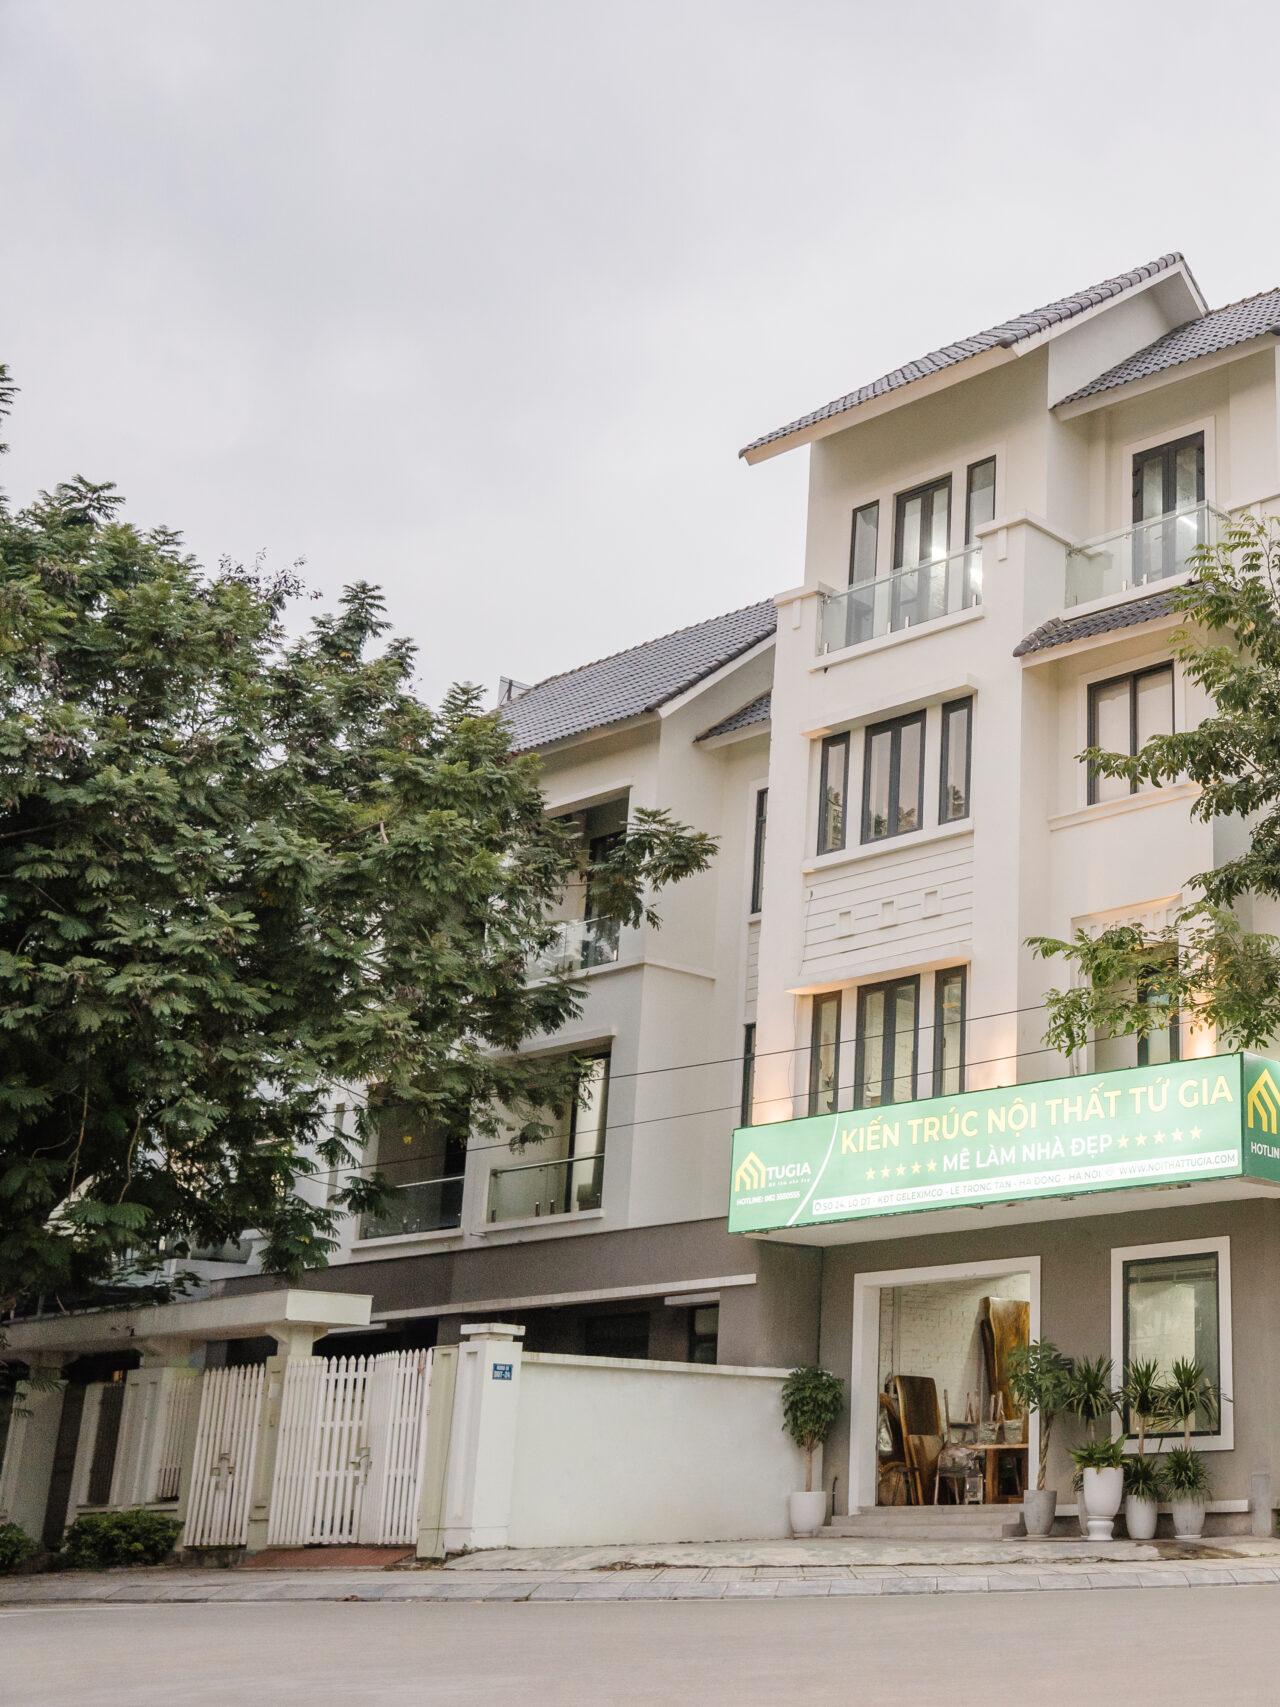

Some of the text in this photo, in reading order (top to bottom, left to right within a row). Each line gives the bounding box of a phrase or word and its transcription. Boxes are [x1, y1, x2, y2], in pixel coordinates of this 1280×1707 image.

[841, 1075, 1234, 1154] KIẾN TRÚC NỘI THẤT TỨ GIA
[766, 1162, 812, 1180] TUGIA
[943, 1134, 1113, 1172] MÊ LÀM NHÀ ĐẸP
